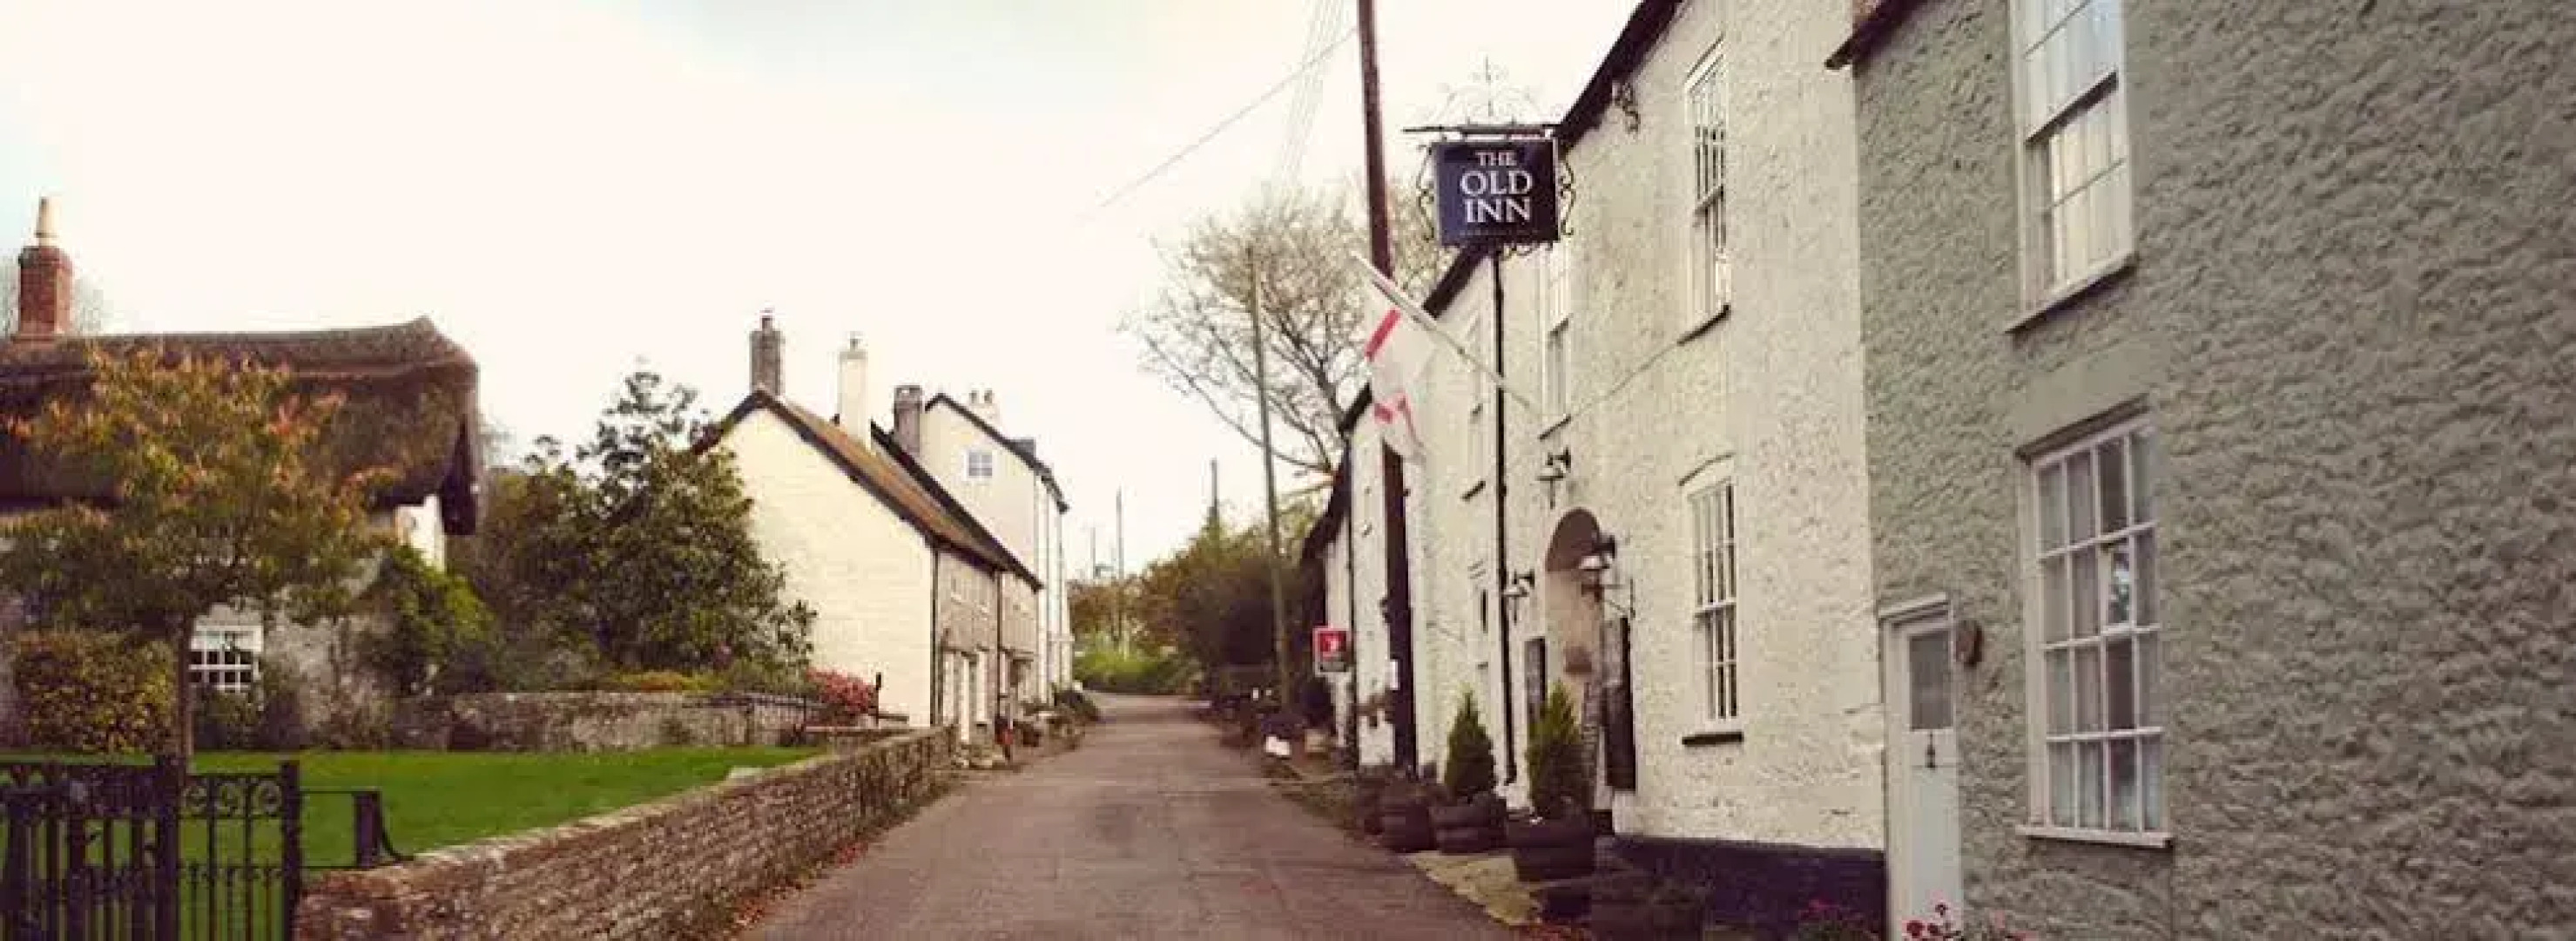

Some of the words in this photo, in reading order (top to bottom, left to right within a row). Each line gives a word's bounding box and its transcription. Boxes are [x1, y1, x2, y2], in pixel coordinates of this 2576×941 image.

[1475, 151, 1516, 166] THE
[1460, 170, 1532, 195] OLD
[1463, 198, 1530, 222] INN
